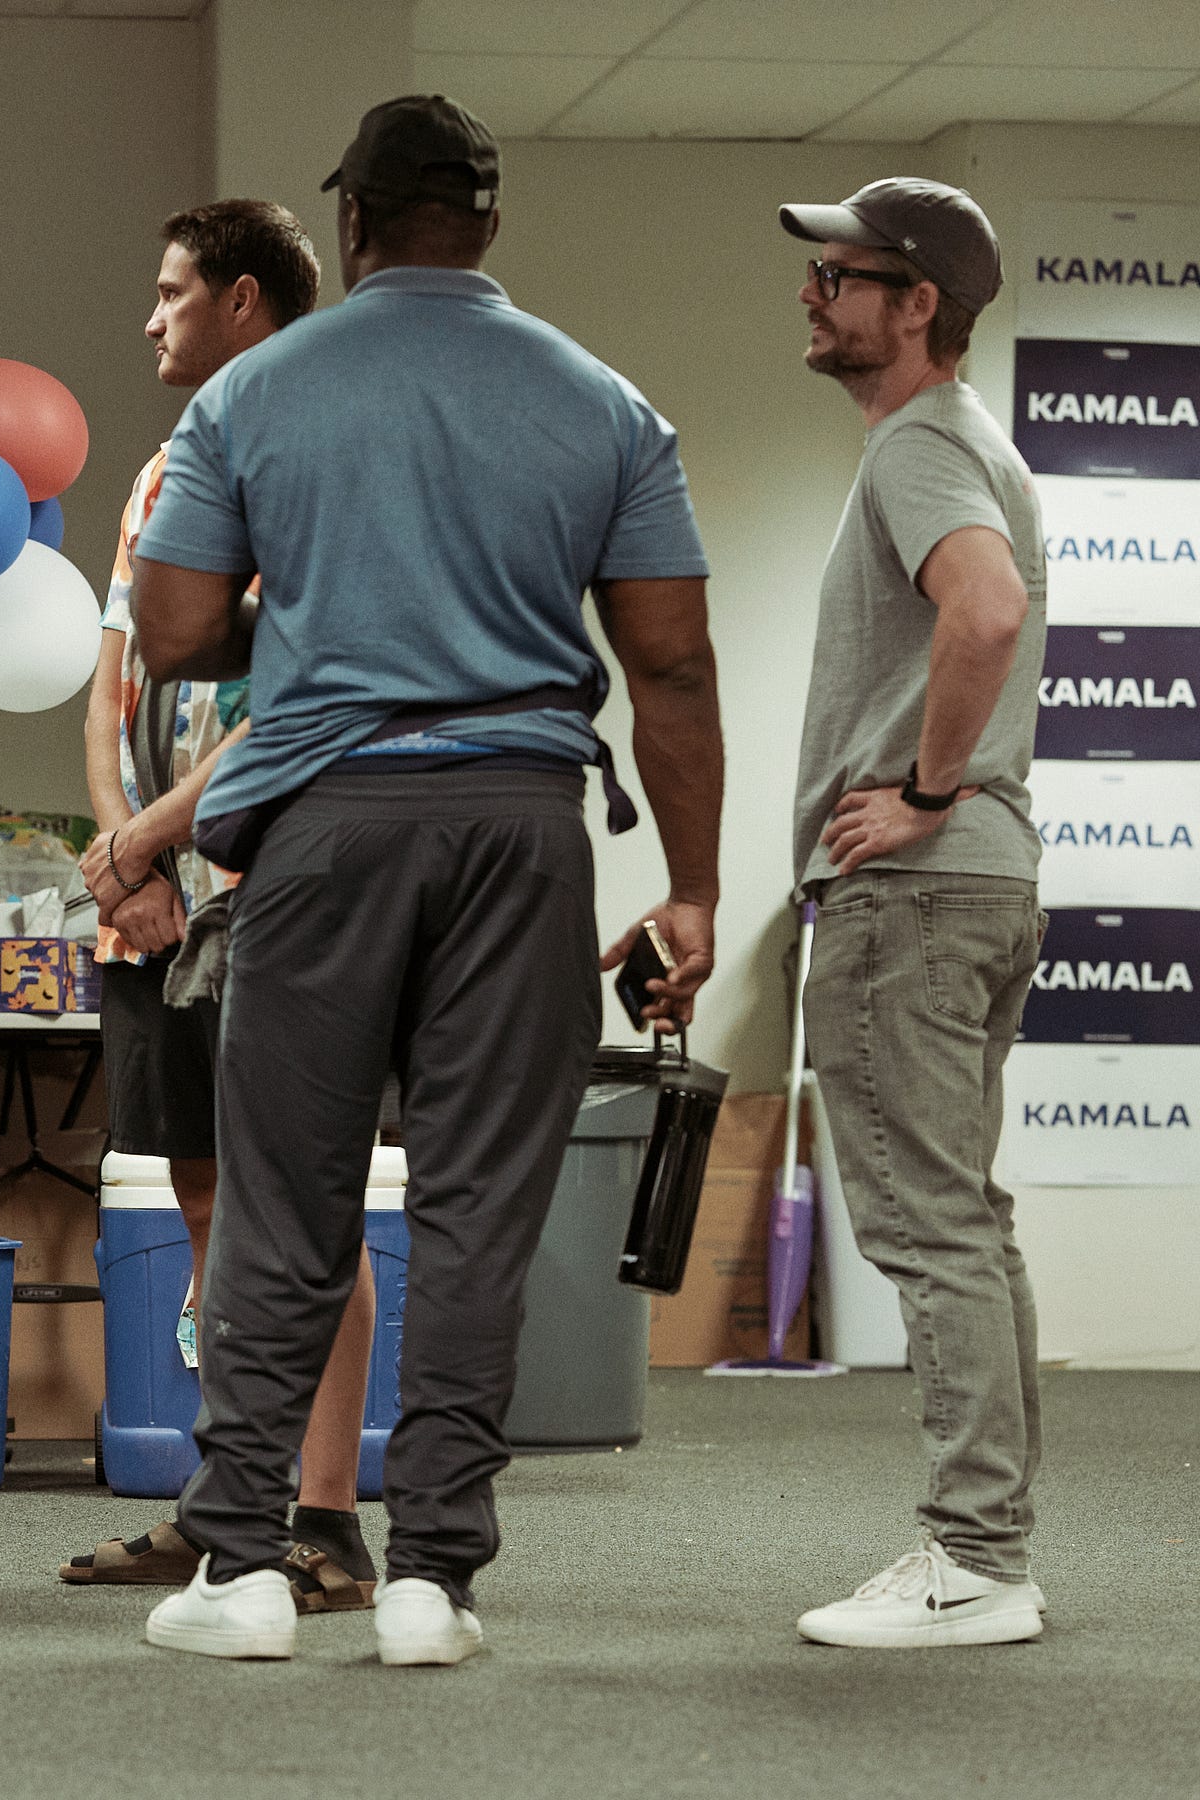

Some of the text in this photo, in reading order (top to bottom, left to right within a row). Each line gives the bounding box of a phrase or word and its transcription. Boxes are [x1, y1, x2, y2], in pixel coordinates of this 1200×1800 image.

[1036, 257, 1200, 287] KAMALA
[1027, 391, 1199, 427] KAMALA
[1023, 1102, 1191, 1128] KAMALA
